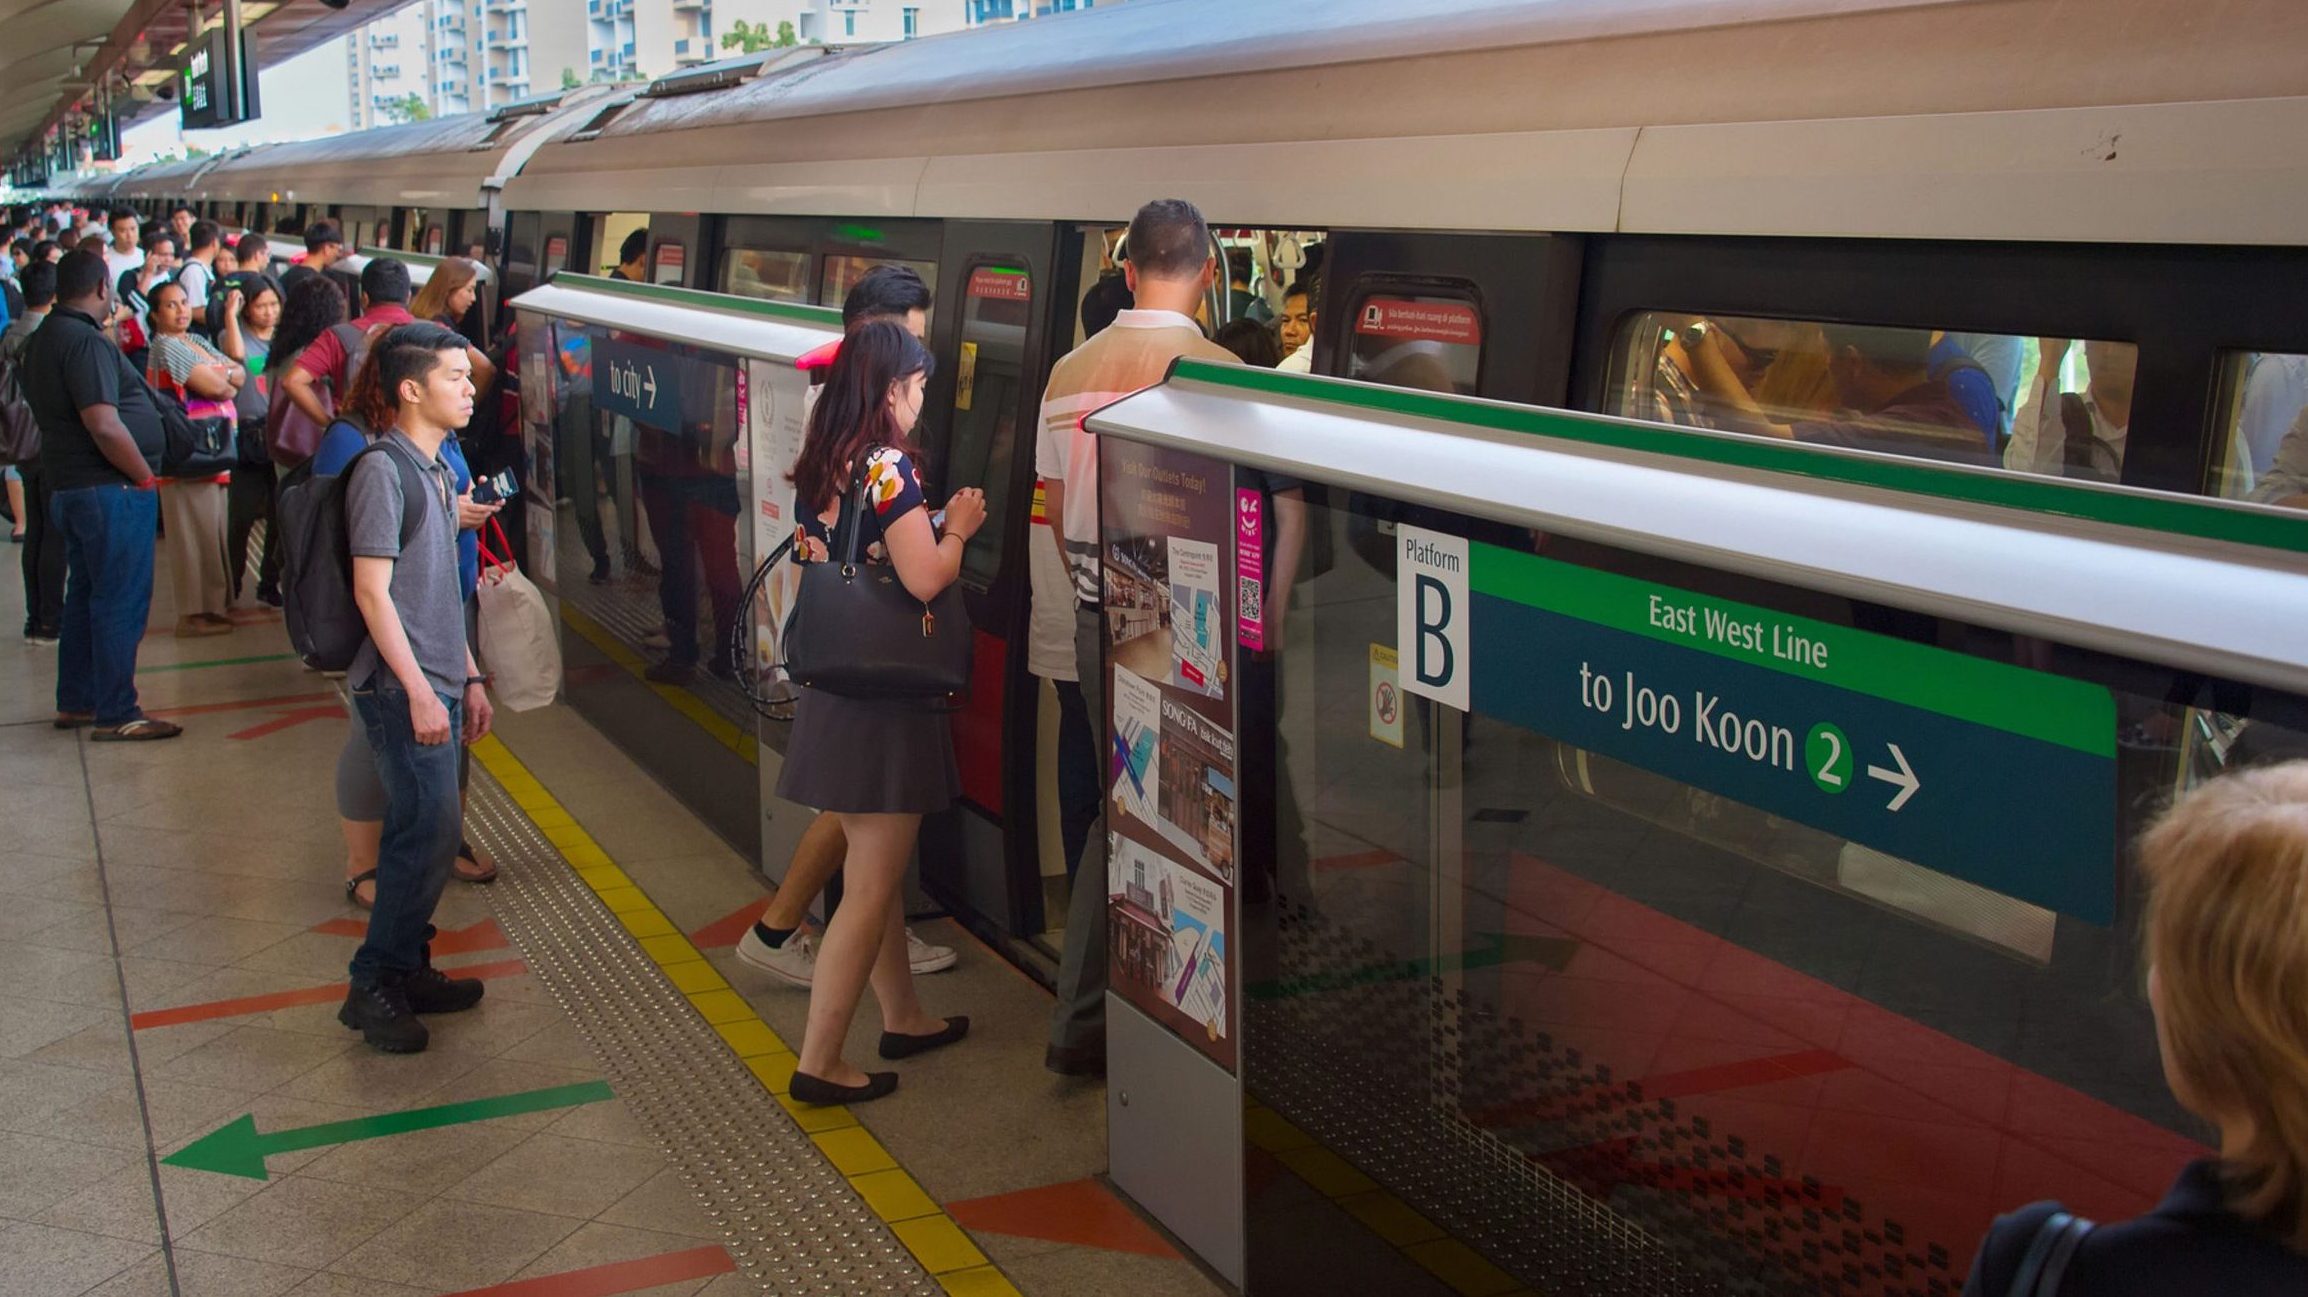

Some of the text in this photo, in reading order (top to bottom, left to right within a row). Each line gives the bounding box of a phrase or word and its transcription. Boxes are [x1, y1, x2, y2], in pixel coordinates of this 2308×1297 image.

[610, 359, 641, 409] to city
[1181, 472, 1207, 496] Today!
[1406, 538, 1460, 574] Platform
[1415, 572, 1455, 688] B
[1649, 594, 1828, 669] East West Line
[1163, 701, 1186, 726] SONG
[1187, 717, 1198, 736] FA
[1580, 662, 1842, 786] to Joo Koon 2
